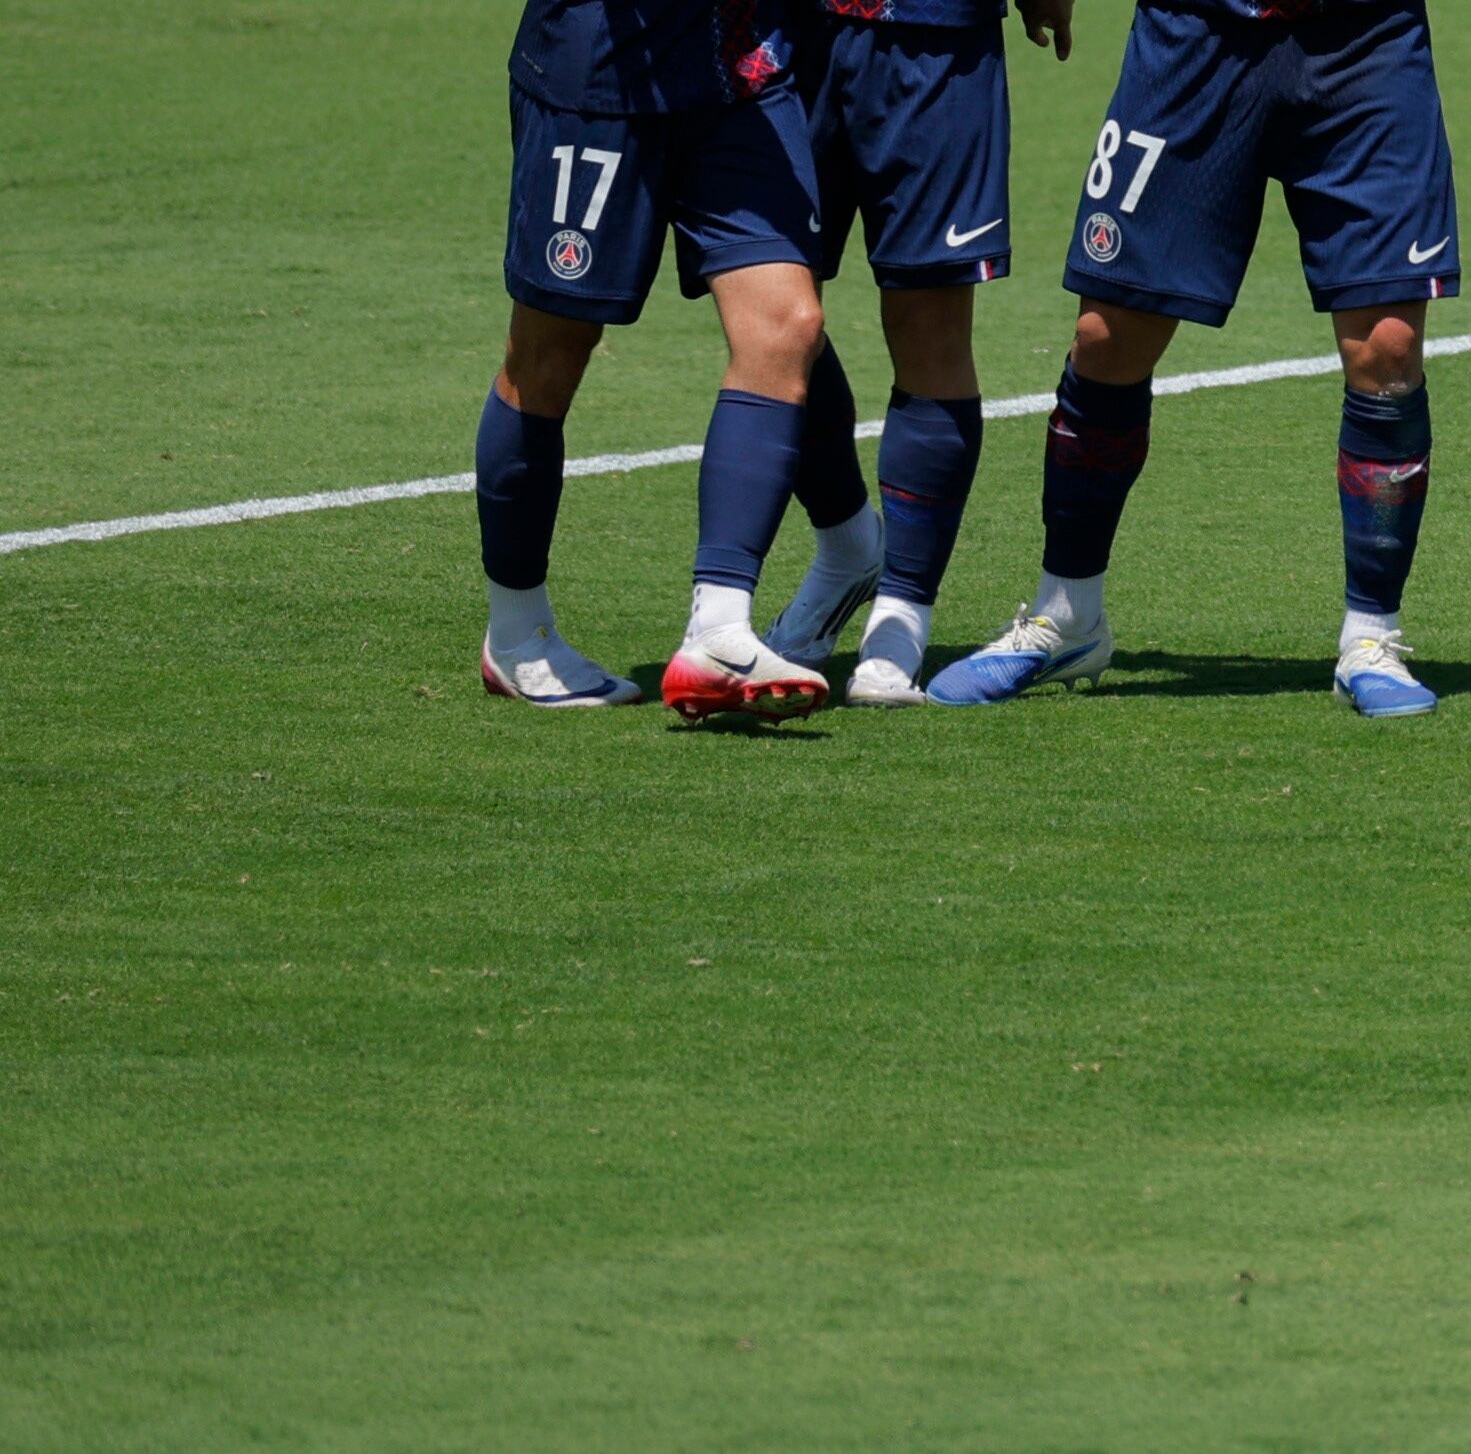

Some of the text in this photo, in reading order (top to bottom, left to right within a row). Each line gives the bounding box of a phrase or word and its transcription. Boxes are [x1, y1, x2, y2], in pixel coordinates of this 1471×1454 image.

[551, 144, 622, 231] 17
[1086, 119, 1166, 214] 87
[556, 232, 587, 249] PARIS
